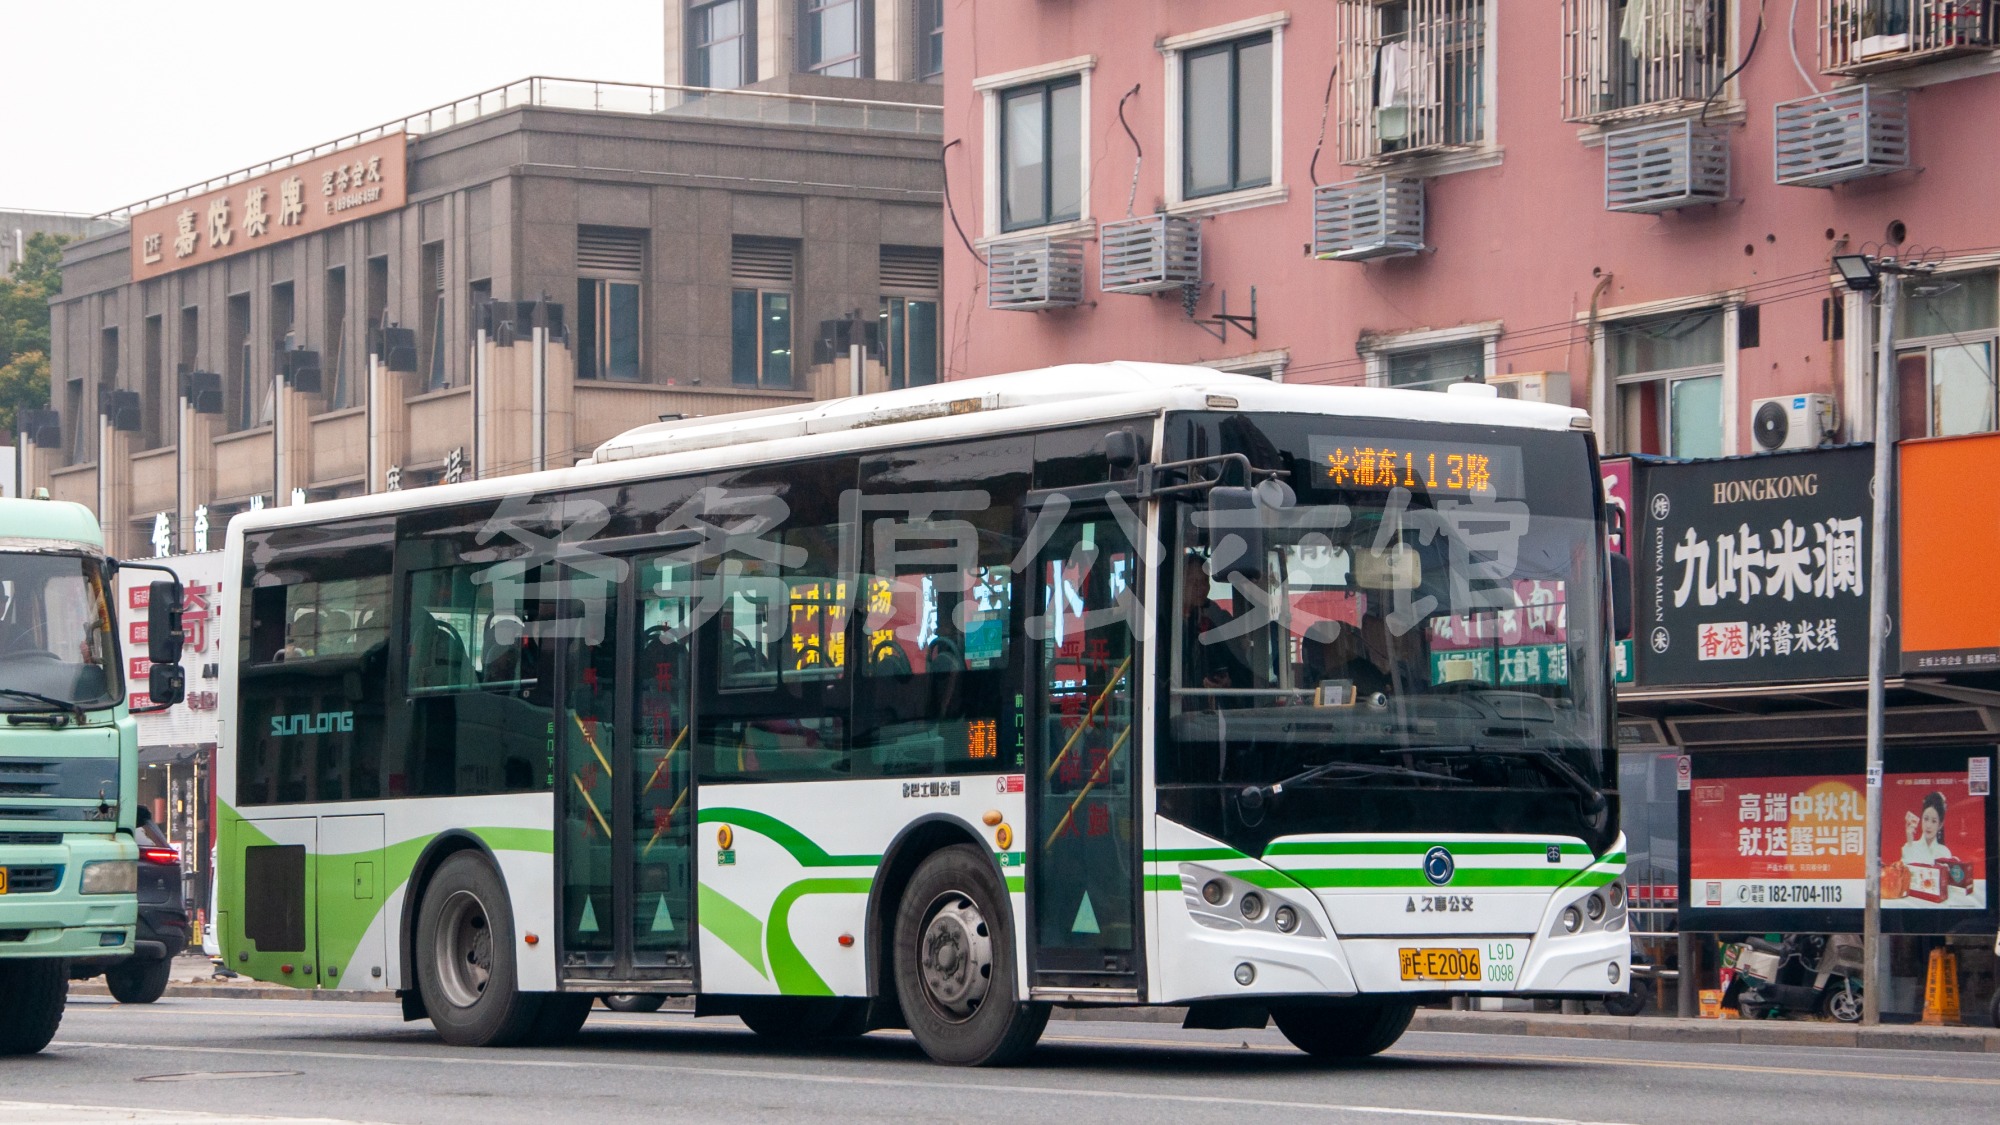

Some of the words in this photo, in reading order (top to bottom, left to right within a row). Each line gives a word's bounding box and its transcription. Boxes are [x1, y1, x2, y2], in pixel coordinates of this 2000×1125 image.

[174, 177, 303, 258] 嘉悦棋牌
[1713, 473, 1818, 504] HONGKONG
[1655, 526, 1665, 572] KOWKA
[1673, 516, 1864, 608] 九咔米澜
[1655, 574, 1665, 622] MAILAN
[1701, 625, 1746, 658] 香港
[1750, 618, 1840, 658] 炸酱米线
[271, 711, 353, 736] SUNLONG
[1015, 694, 1024, 767] 前门上车
[1738, 791, 1864, 823] 高端中秋礼
[1738, 826, 1864, 856] 就选蟹兴阁
[1421, 896, 1474, 912] 久事公交
[1768, 885, 1842, 903] 182-1704-1113
[1488, 944, 1514, 961] L9D
[1488, 965, 1514, 982] 0098
